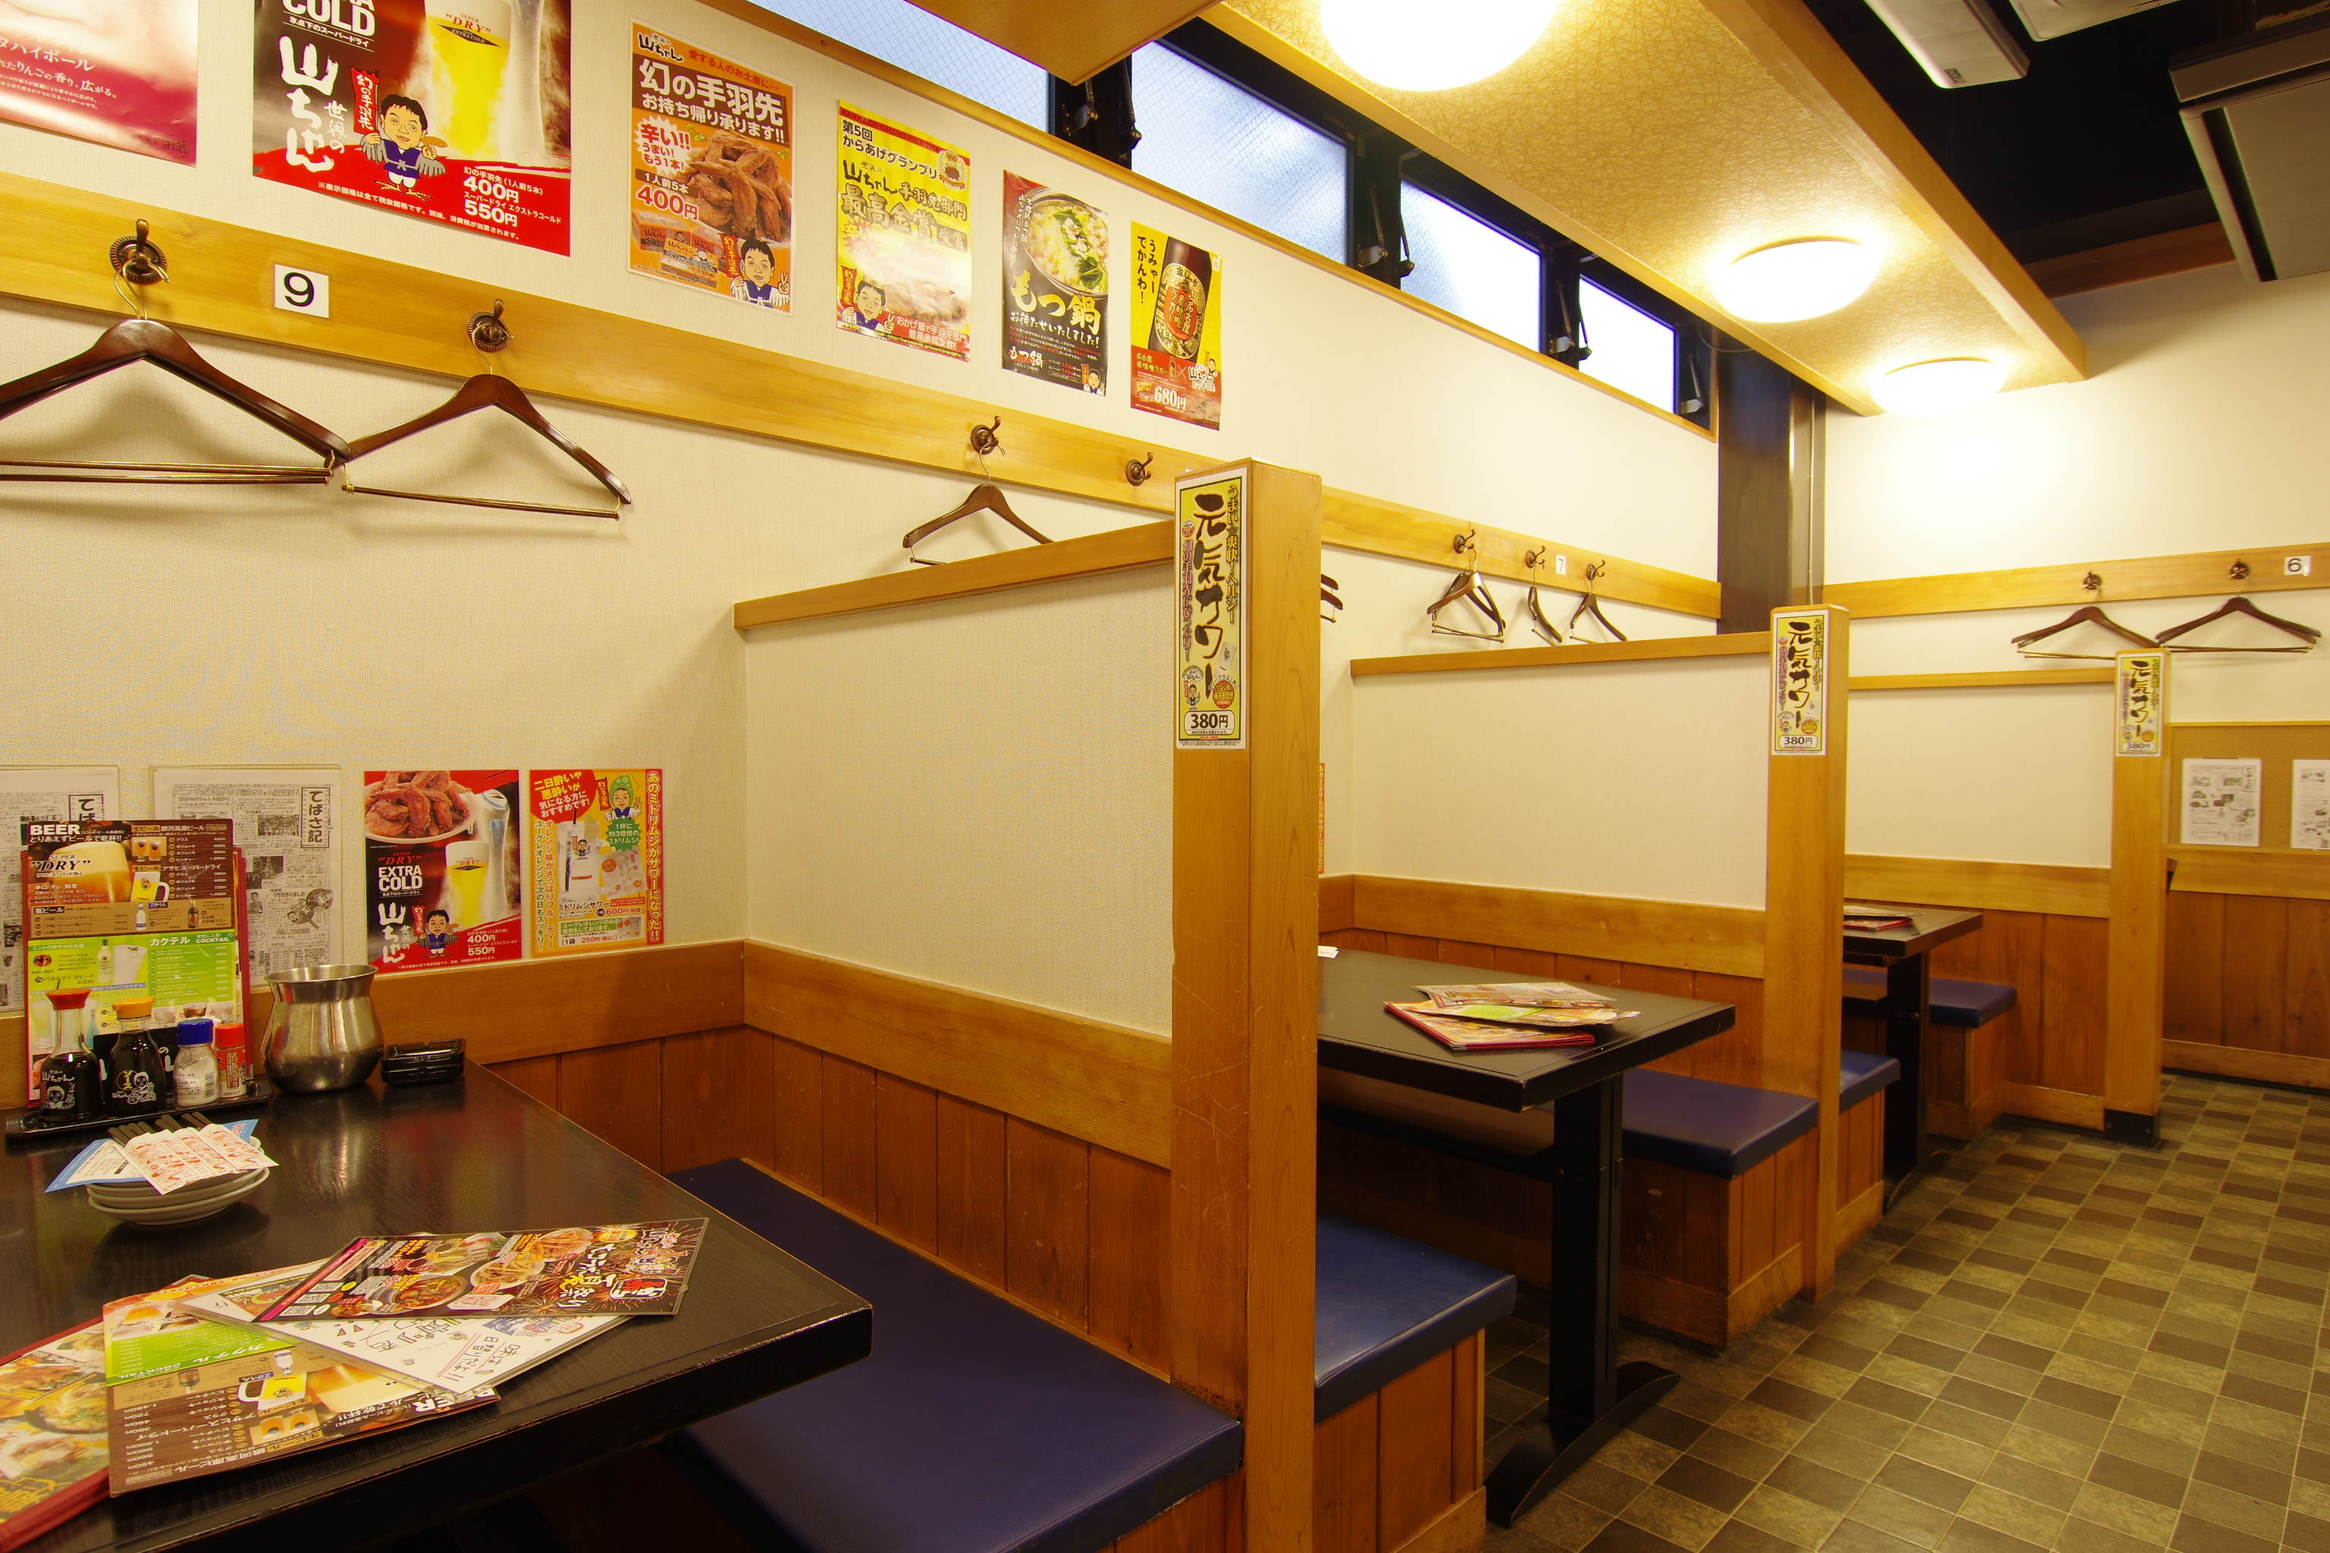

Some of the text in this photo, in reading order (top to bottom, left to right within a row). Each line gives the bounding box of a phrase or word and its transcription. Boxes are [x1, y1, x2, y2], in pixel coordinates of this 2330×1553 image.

[281, 0, 376, 36] COLD
[638, 32, 684, 63] 山ちゃん
[279, 35, 340, 173] 山ちゃん
[639, 57, 785, 127] 幻の手羽先
[641, 92, 786, 144] お持ち帰り承ります!!
[842, 119, 873, 142] 第5回
[640, 121, 691, 151] 辛い!!
[843, 134, 937, 180] からあげグランプリ
[463, 175, 519, 204] 400円
[644, 173, 690, 194] 1人前5本
[842, 159, 897, 195] 山ちゃん
[463, 190, 562, 225] スーパードライ エクストラコールド
[464, 198, 518, 228] 550円
[637, 186, 699, 221] 400円
[1137, 235, 1147, 305] てかんわ!
[283, 271, 315, 308] 9
[1011, 269, 1101, 336] もつ鍋
[1009, 311, 1101, 349] お待たせいたしました!
[1008, 345, 1043, 369] もつ鍋
[1154, 385, 1187, 411] 680円
[2287, 557, 2302, 573] 6
[1193, 493, 1228, 701] 元気サワー
[1788, 621, 1814, 730] 元気サワー
[1190, 713, 1230, 729] 380円
[1783, 736, 1814, 746] 380円
[533, 771, 583, 791] 二日酔いや
[538, 790, 588, 810] 気になる方に
[540, 798, 591, 818] おすすめです!
[30, 824, 81, 836] BEER
[378, 865, 422, 877] EXTRA
[378, 875, 423, 892] COLD
[150, 937, 190, 948] カクテル
[195, 936, 231, 945] COCKTAIL
[378, 902, 407, 963] 山ちゃん
[466, 934, 496, 944] 400円
[467, 946, 496, 957] 550円
[192, 1343, 265, 1364] カクテル
[240, 1372, 273, 1383] ZIMA
